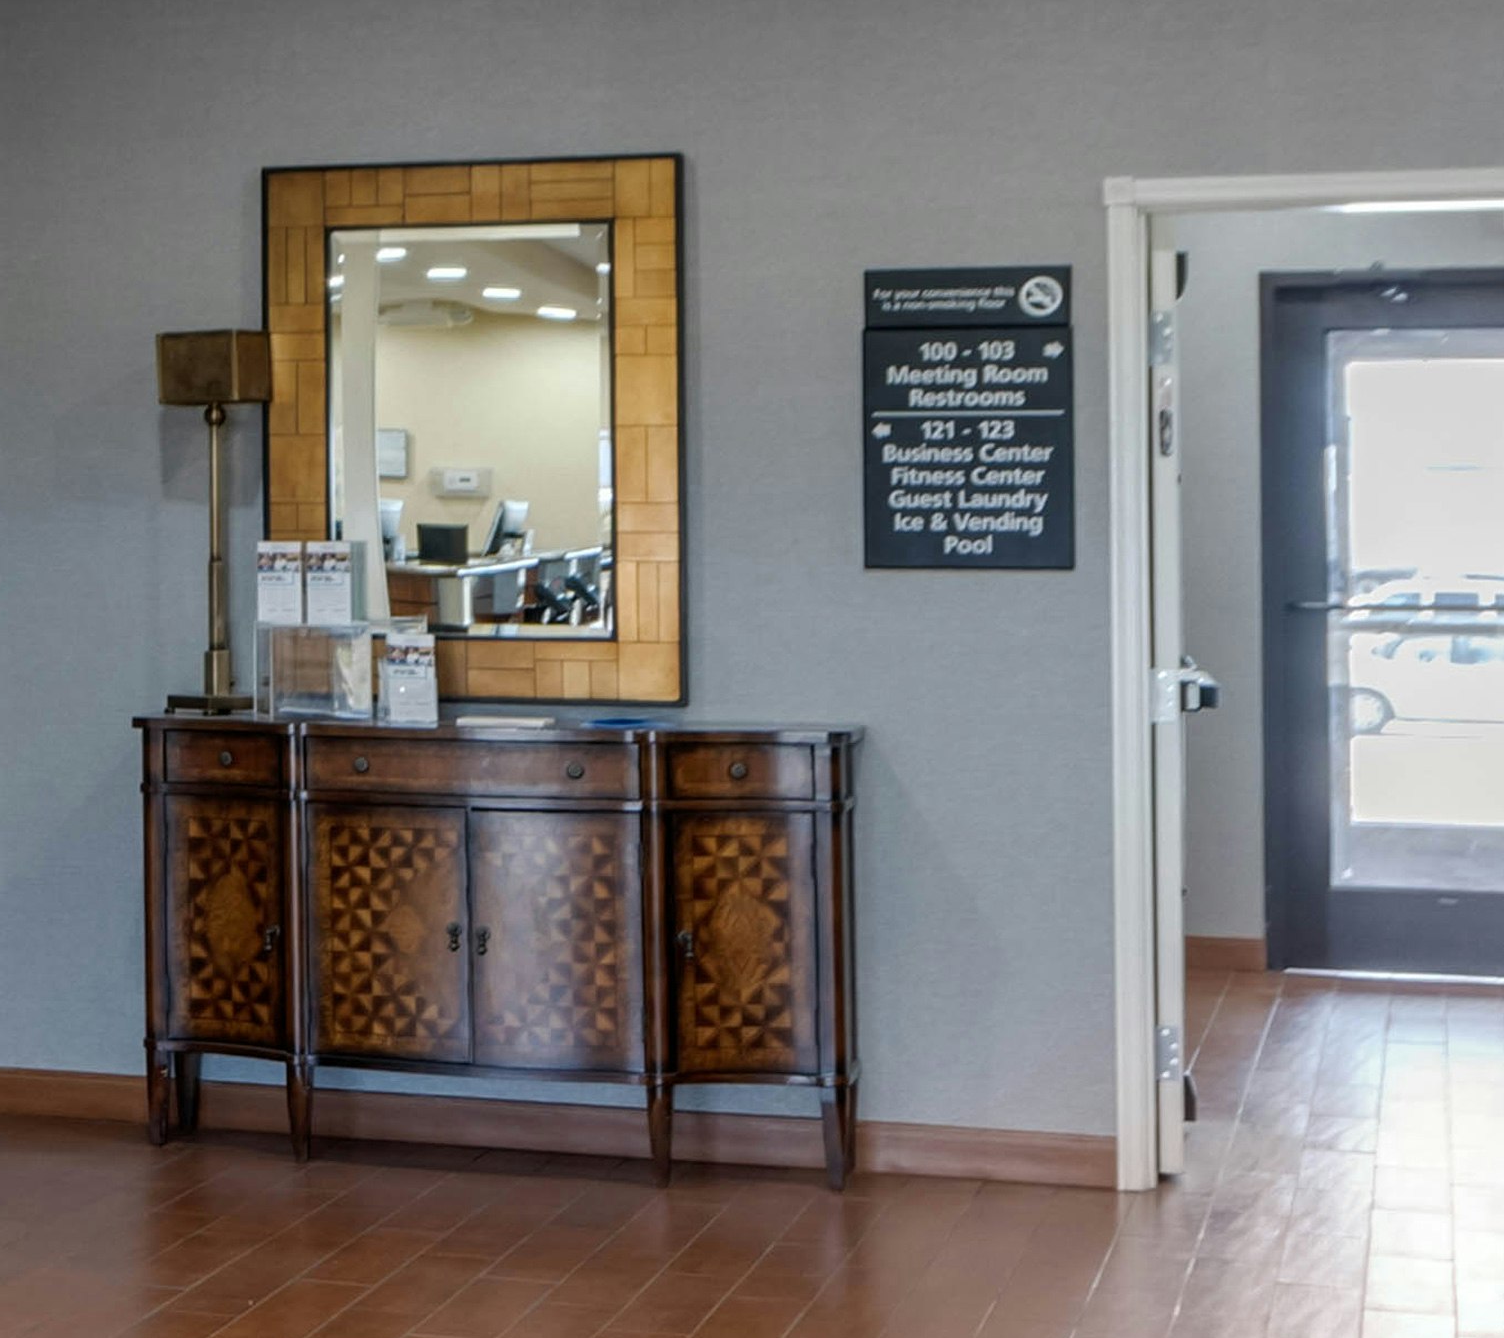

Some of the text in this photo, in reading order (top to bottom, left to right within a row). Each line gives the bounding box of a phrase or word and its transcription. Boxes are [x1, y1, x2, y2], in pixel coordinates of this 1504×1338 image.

[919, 342, 957, 361] 100
[978, 340, 1015, 361] 103
[886, 364, 1049, 389] Meeting Room
[908, 388, 1026, 407] Restrooms
[920, 420, 955, 440] 121
[978, 420, 1015, 440] 123
[882, 442, 1054, 463] Business Center
[890, 465, 1046, 485] Fitness Center
[888, 488, 1049, 513] Guest Laundry
[894, 511, 1043, 537] Ice & Vending
[943, 534, 993, 555] Pool
